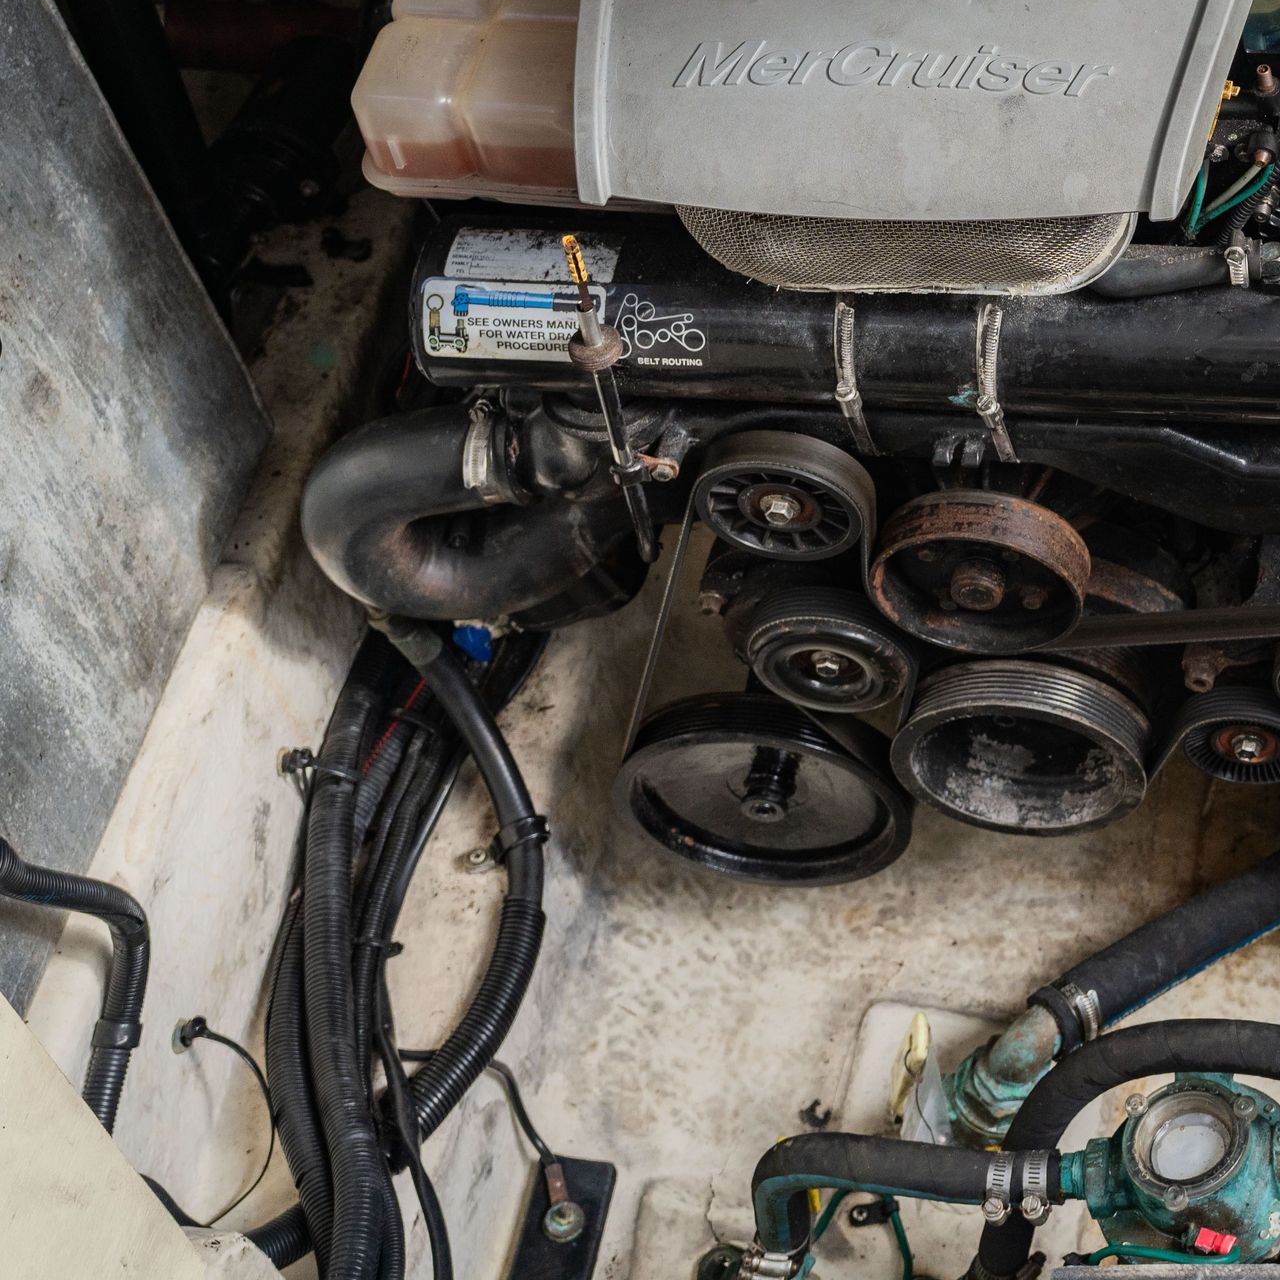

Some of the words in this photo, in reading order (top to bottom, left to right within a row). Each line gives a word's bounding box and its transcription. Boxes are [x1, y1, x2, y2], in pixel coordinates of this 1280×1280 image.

[672, 39, 1115, 98] MerCruiser
[467, 317, 489, 326] SEE
[492, 318, 543, 329] OWNERS
[546, 320, 580, 329] MANU
[479, 329, 502, 338] FOR
[505, 330, 546, 340] WATER
[549, 331, 571, 341] DRA
[497, 341, 569, 352] PROCEDURE
[637, 357, 660, 366] BELT
[662, 358, 703, 367] ROUTING
